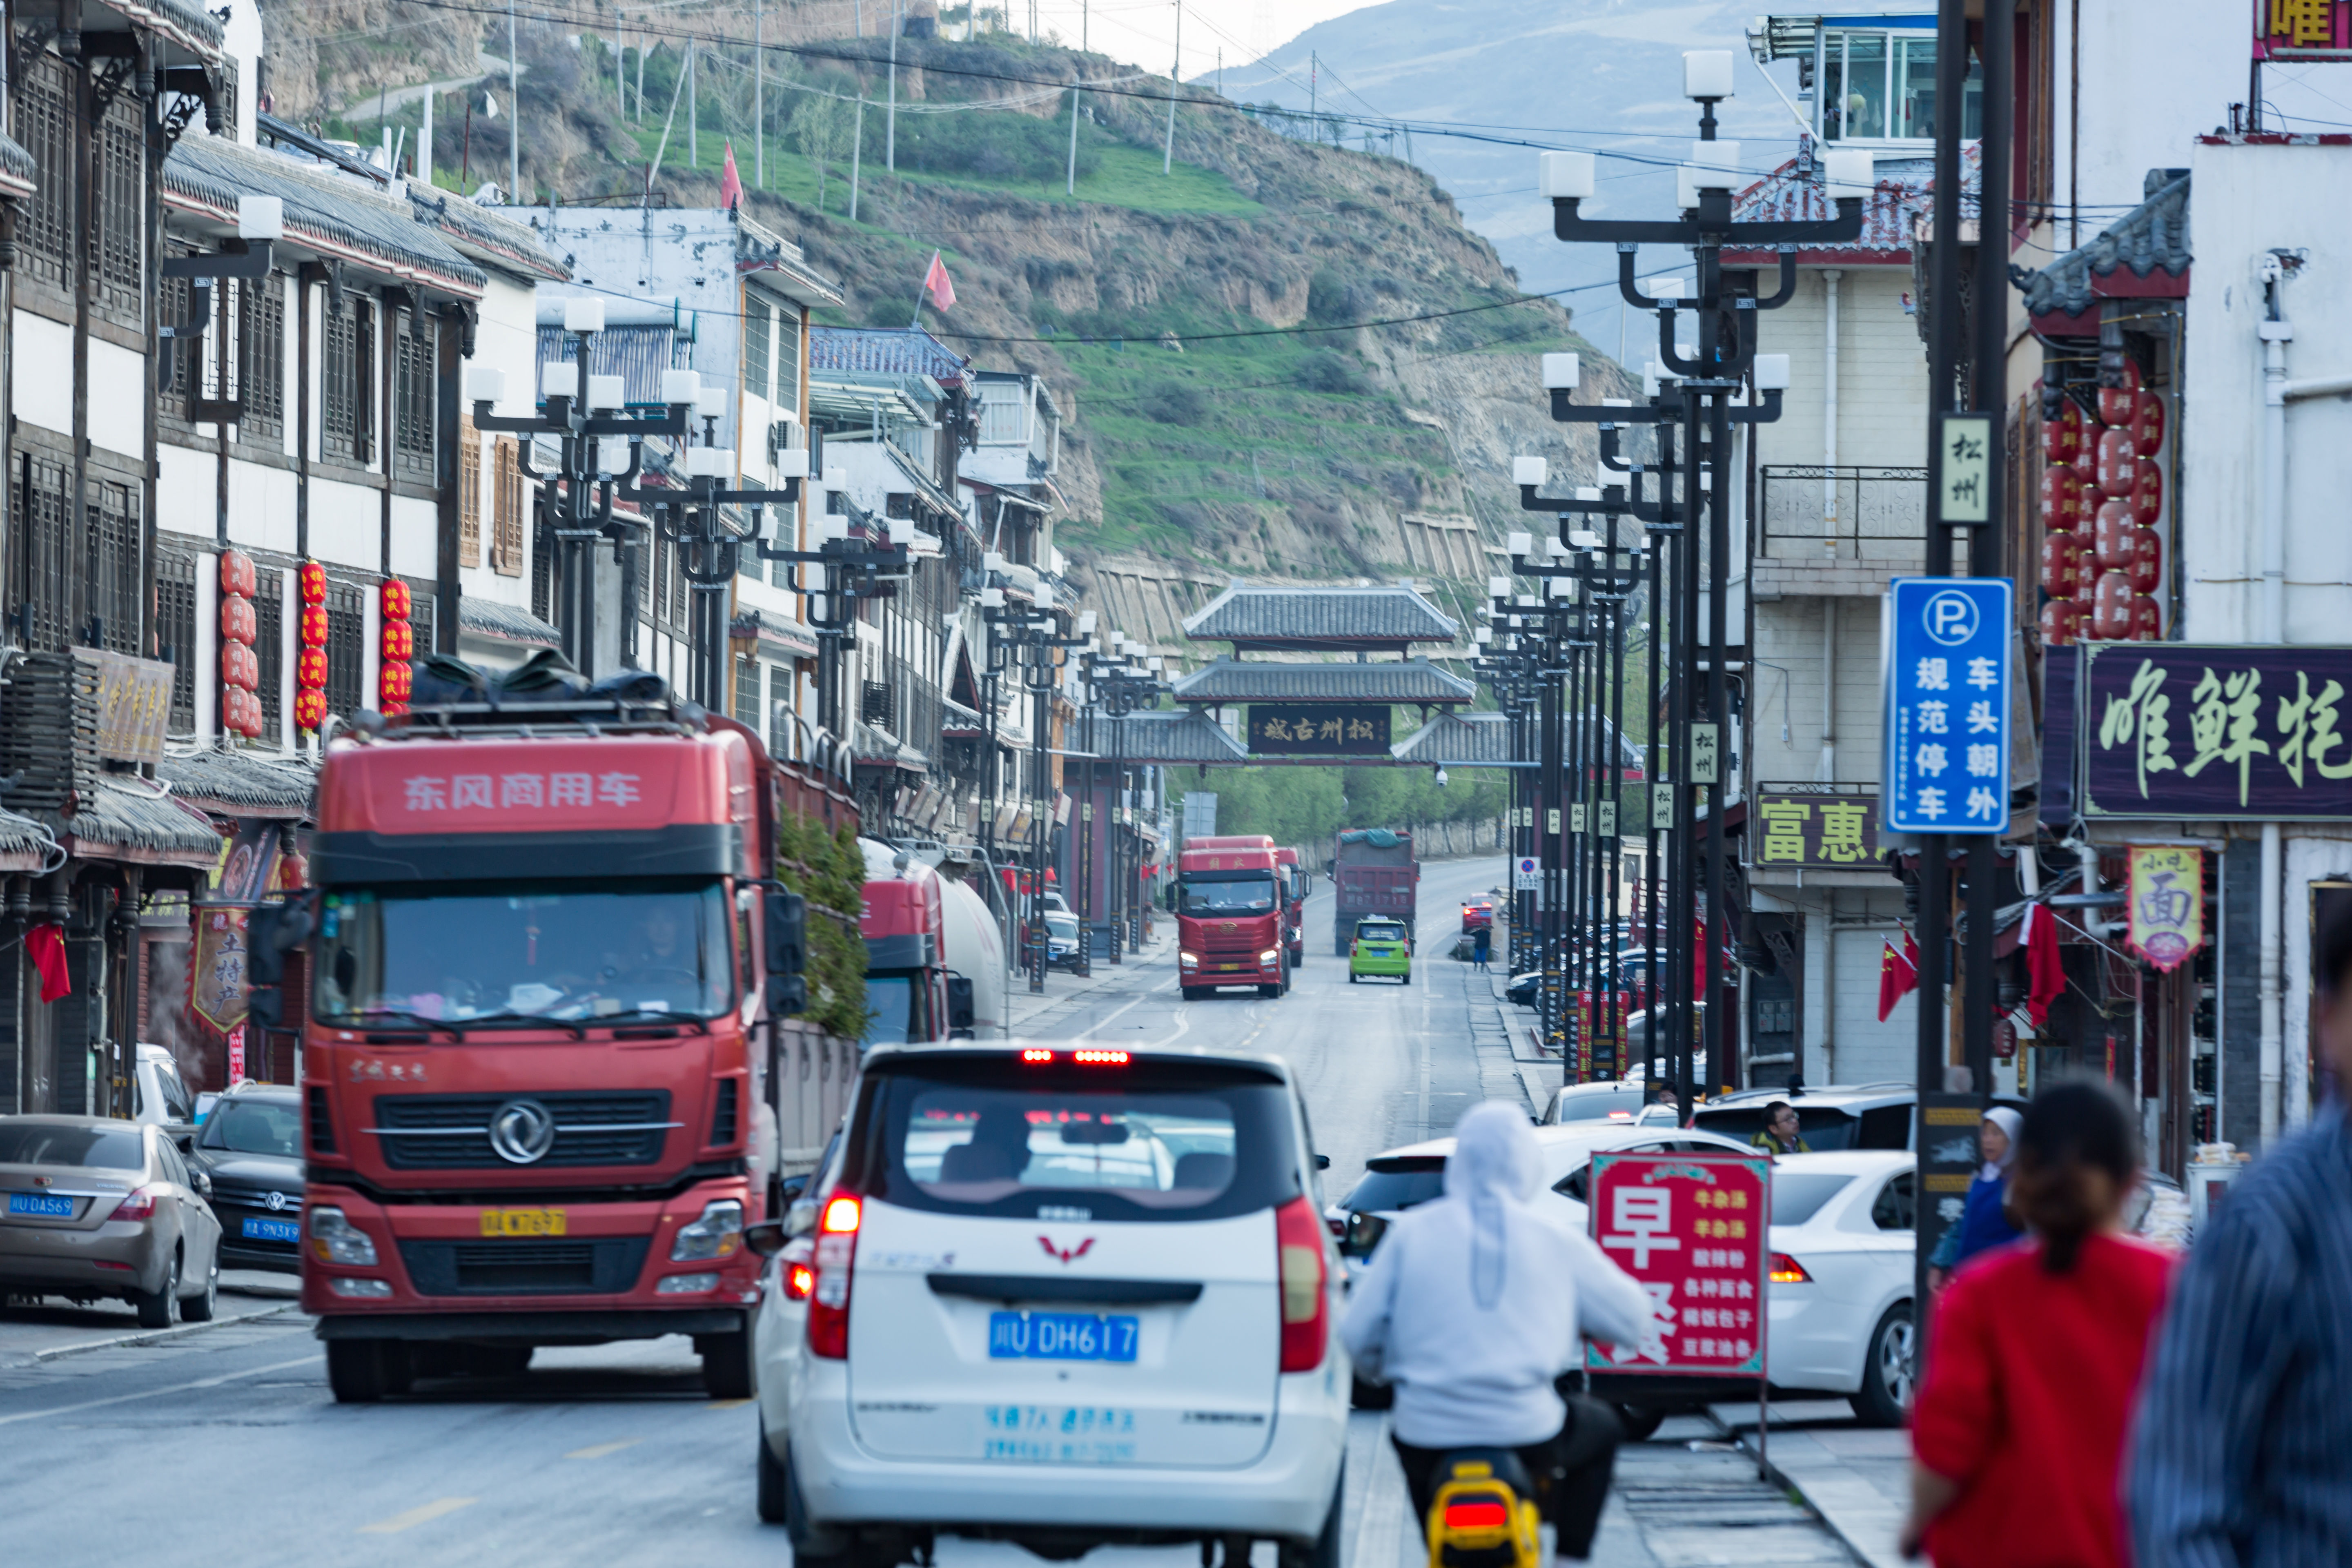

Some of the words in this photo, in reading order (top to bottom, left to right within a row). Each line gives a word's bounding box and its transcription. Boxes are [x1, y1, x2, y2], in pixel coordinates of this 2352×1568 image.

[1951, 433, 1982, 509] 松州
[1936, 599, 1967, 635] P
[1695, 731, 1714, 777] 松州
[1915, 657, 1950, 822] 规范停车
[1965, 656, 1999, 822] 车头朝外
[403, 771, 642, 811] 东风商用车
[1656, 789, 1671, 824] 松州
[1573, 807, 1583, 829] 松州
[1601, 805, 1614, 833] 松州
[1761, 799, 1887, 863] 富惠
[2140, 870, 2193, 930] 面
[212, 933, 246, 1016] 土特产
[1683, 1276, 1754, 1299] 各种面食
